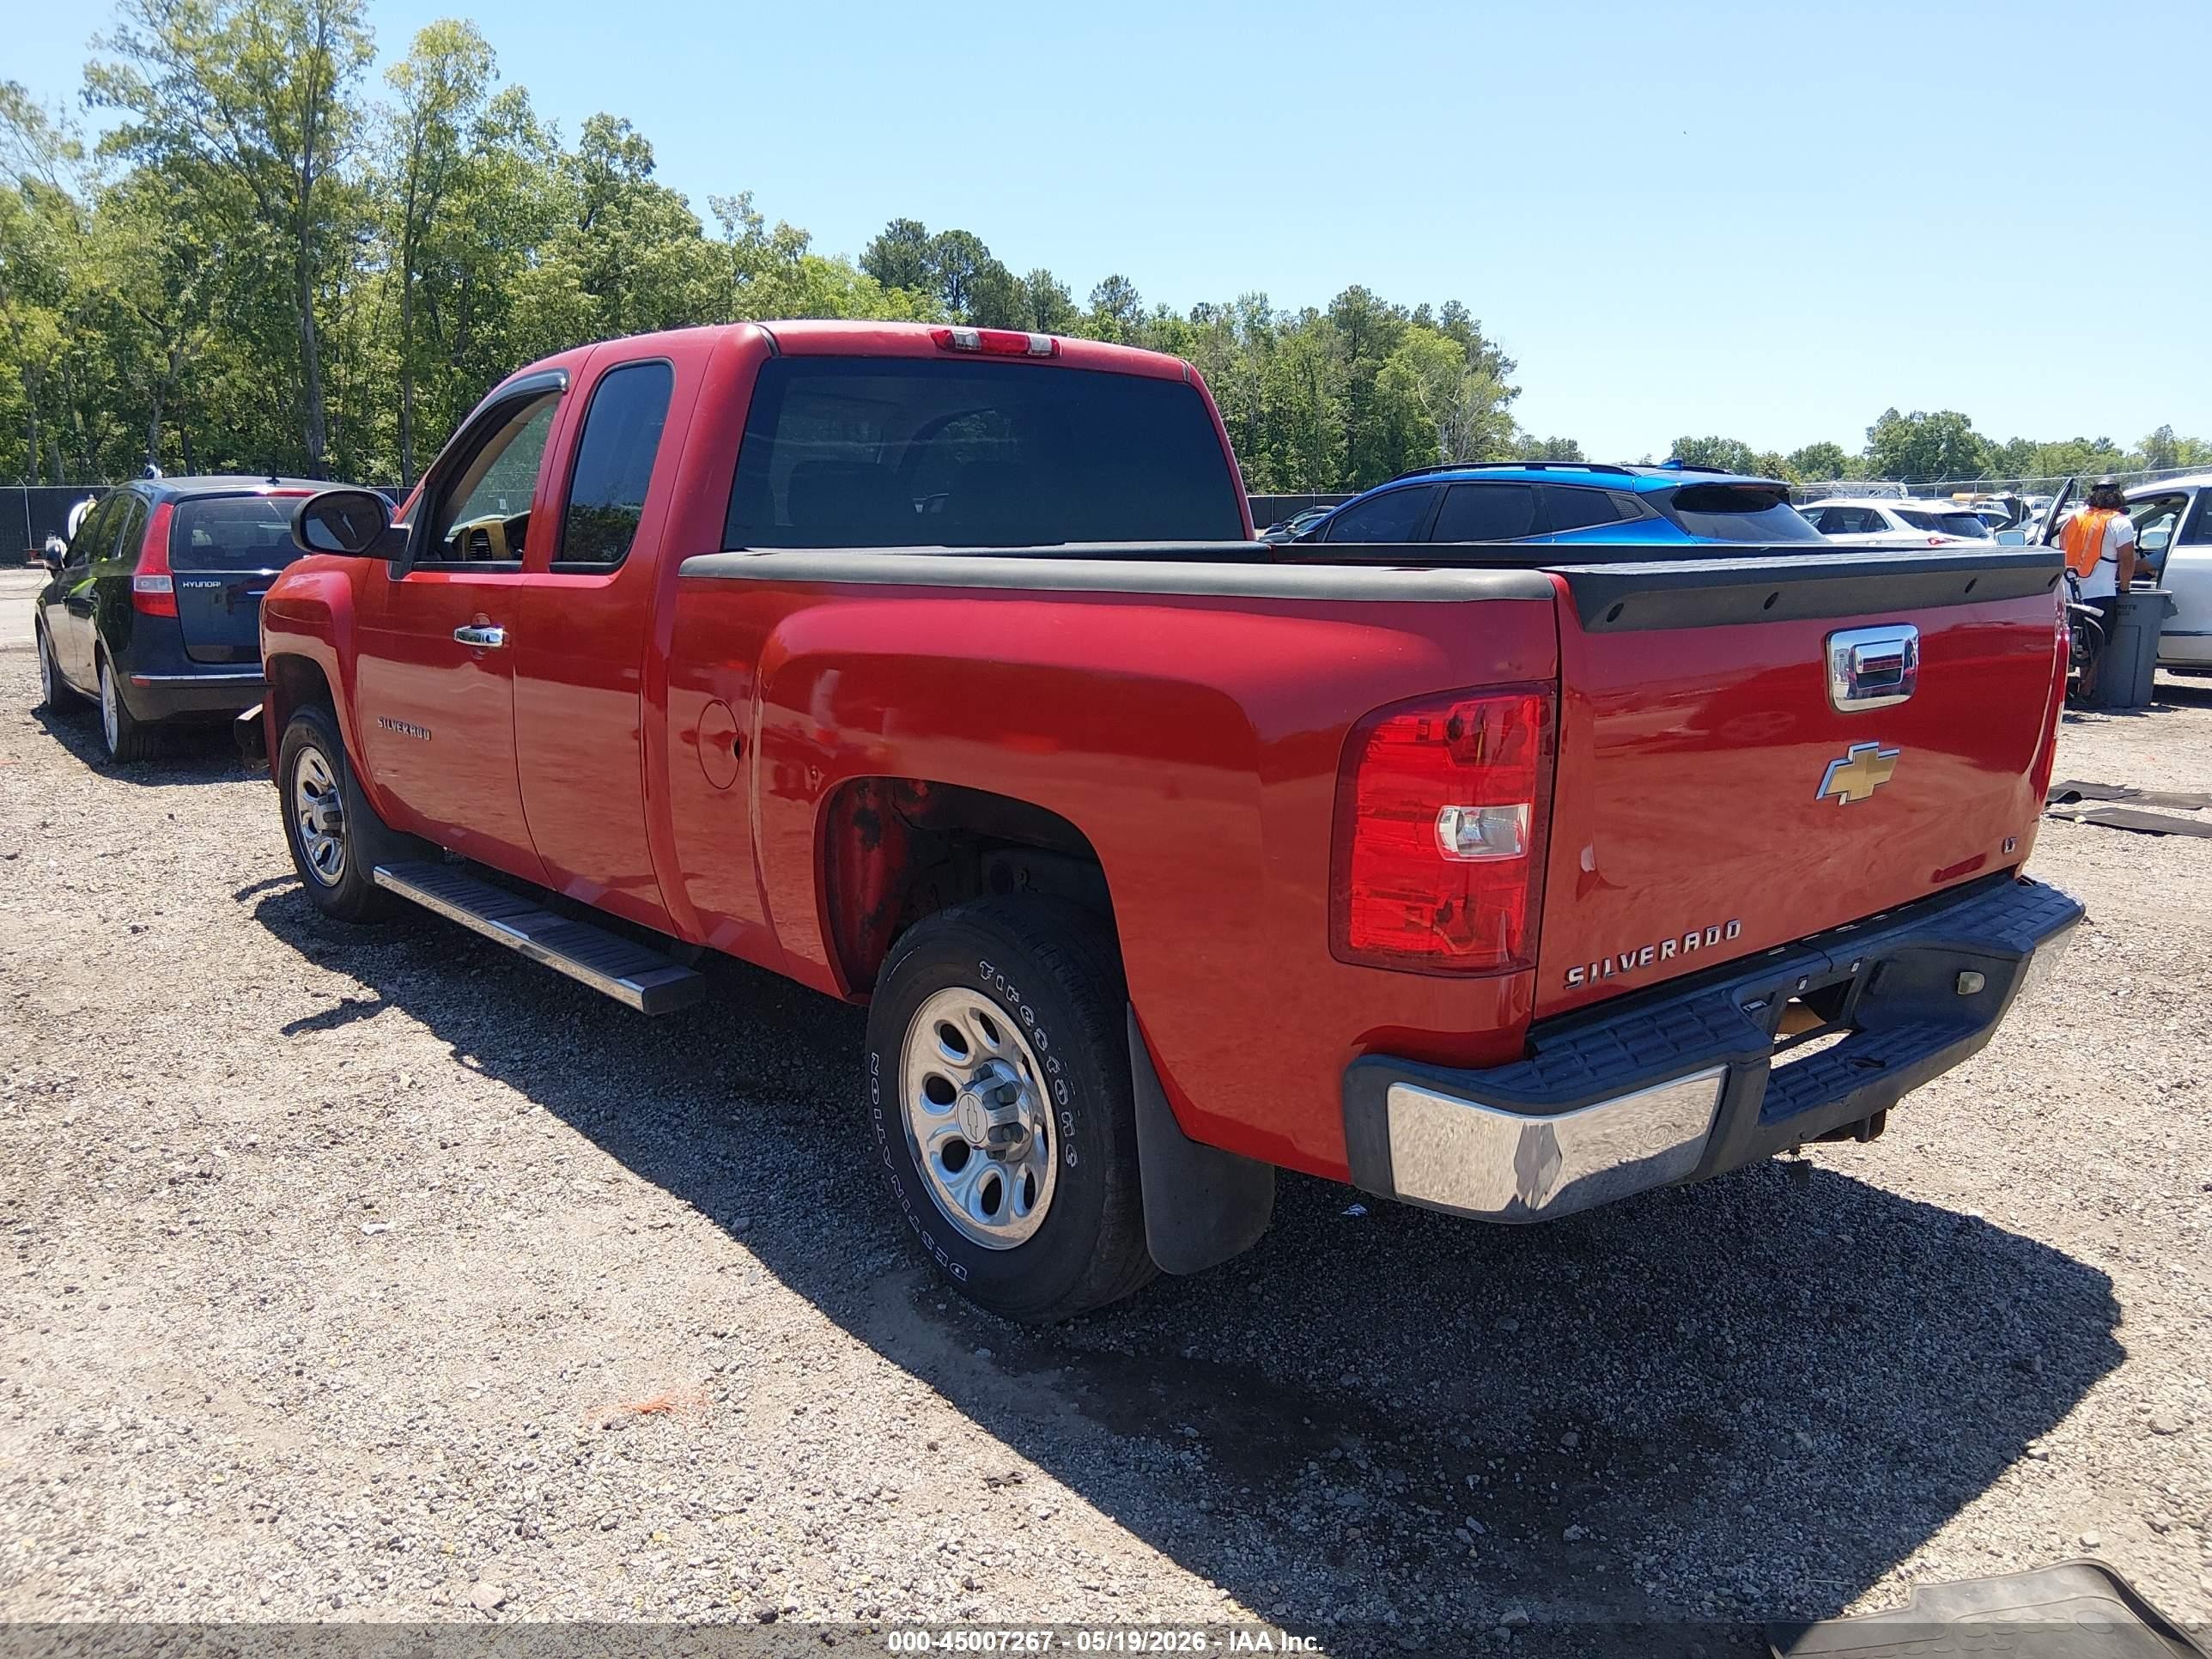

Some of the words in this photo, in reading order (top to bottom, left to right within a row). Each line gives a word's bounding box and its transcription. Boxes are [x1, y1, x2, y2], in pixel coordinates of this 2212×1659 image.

[377, 715, 432, 741] SILVERADO
[1564, 919, 1741, 989] SILVERADO
[871, 1052, 969, 1282] DESTINATION
